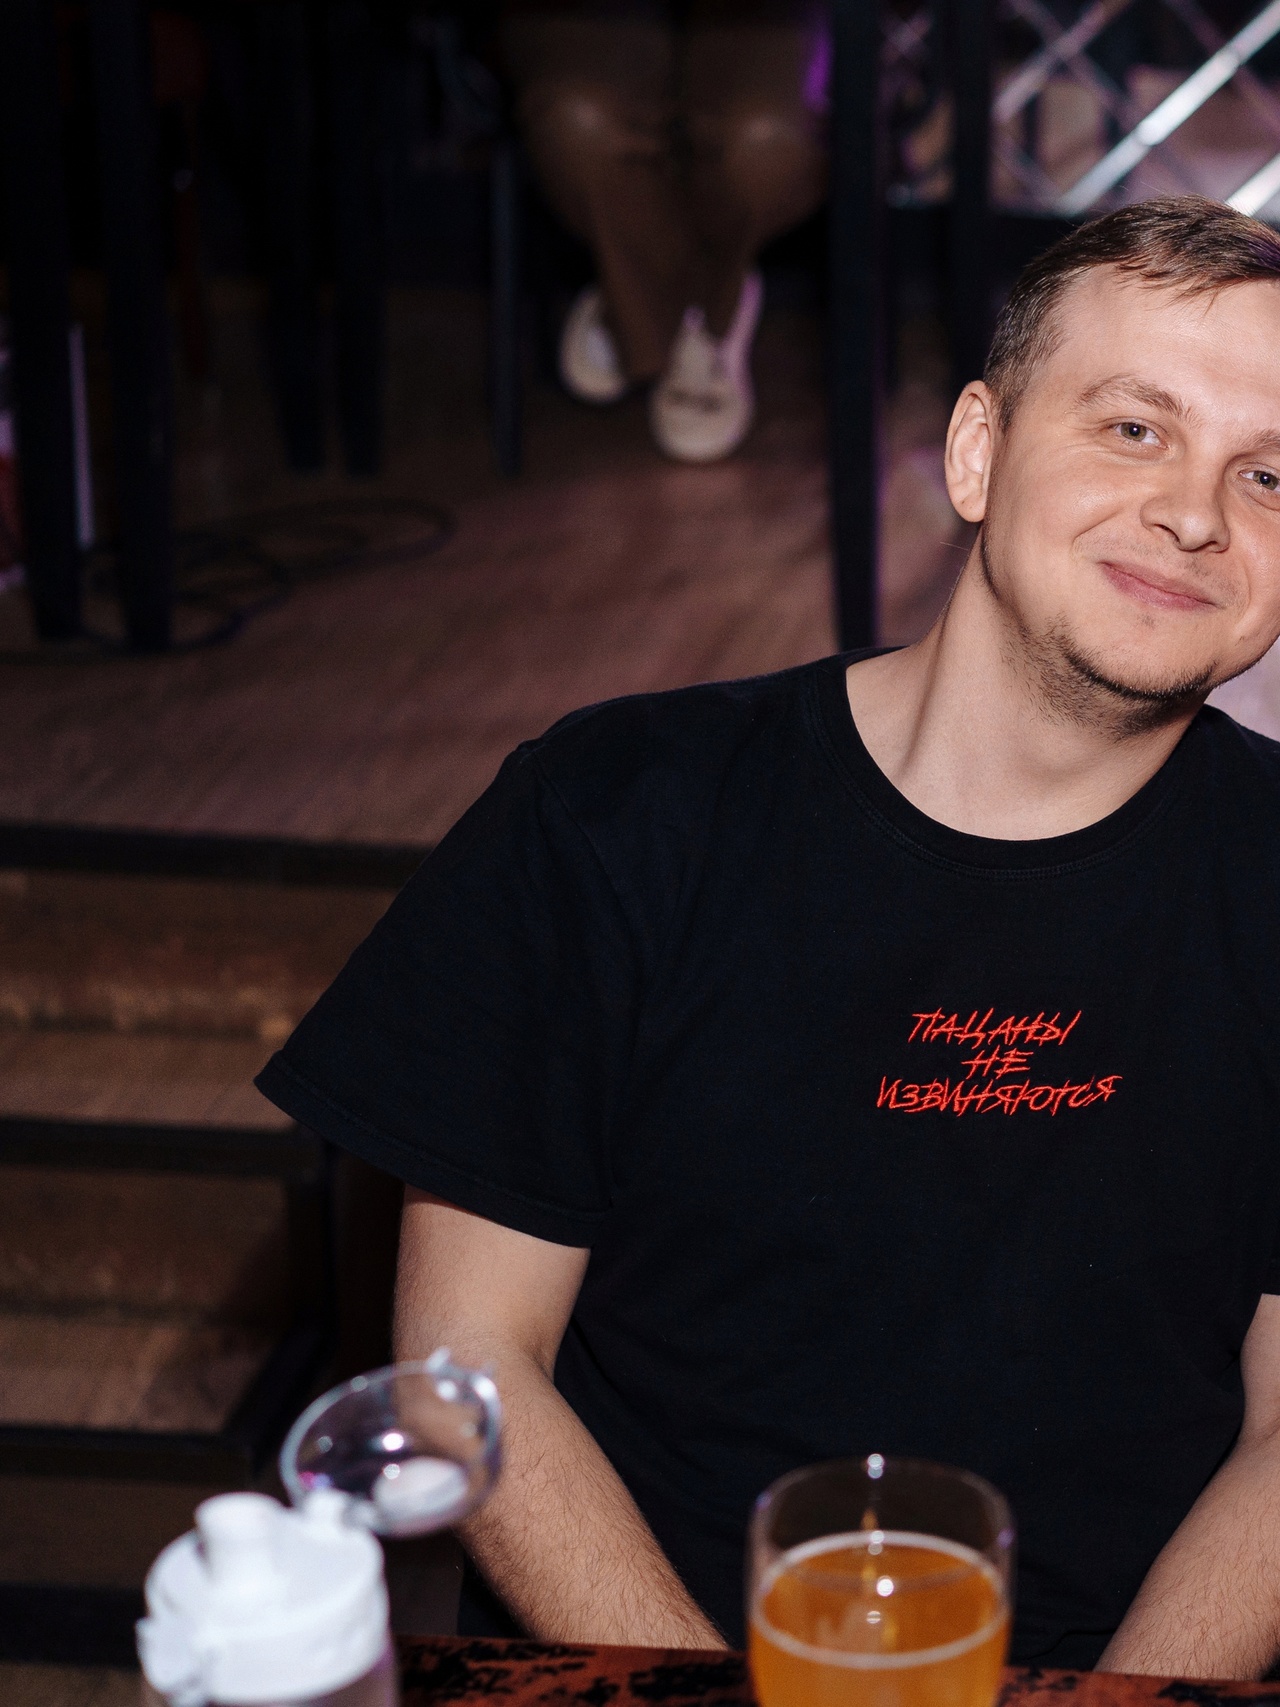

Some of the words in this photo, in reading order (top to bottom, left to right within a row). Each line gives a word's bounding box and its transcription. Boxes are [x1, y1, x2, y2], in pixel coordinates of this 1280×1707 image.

[907, 1007, 1082, 1049] ПАЦАНЫ
[961, 1045, 1034, 1080] НЕ
[875, 1075, 1123, 1117] ИЗВИНЯЮТСЯ
